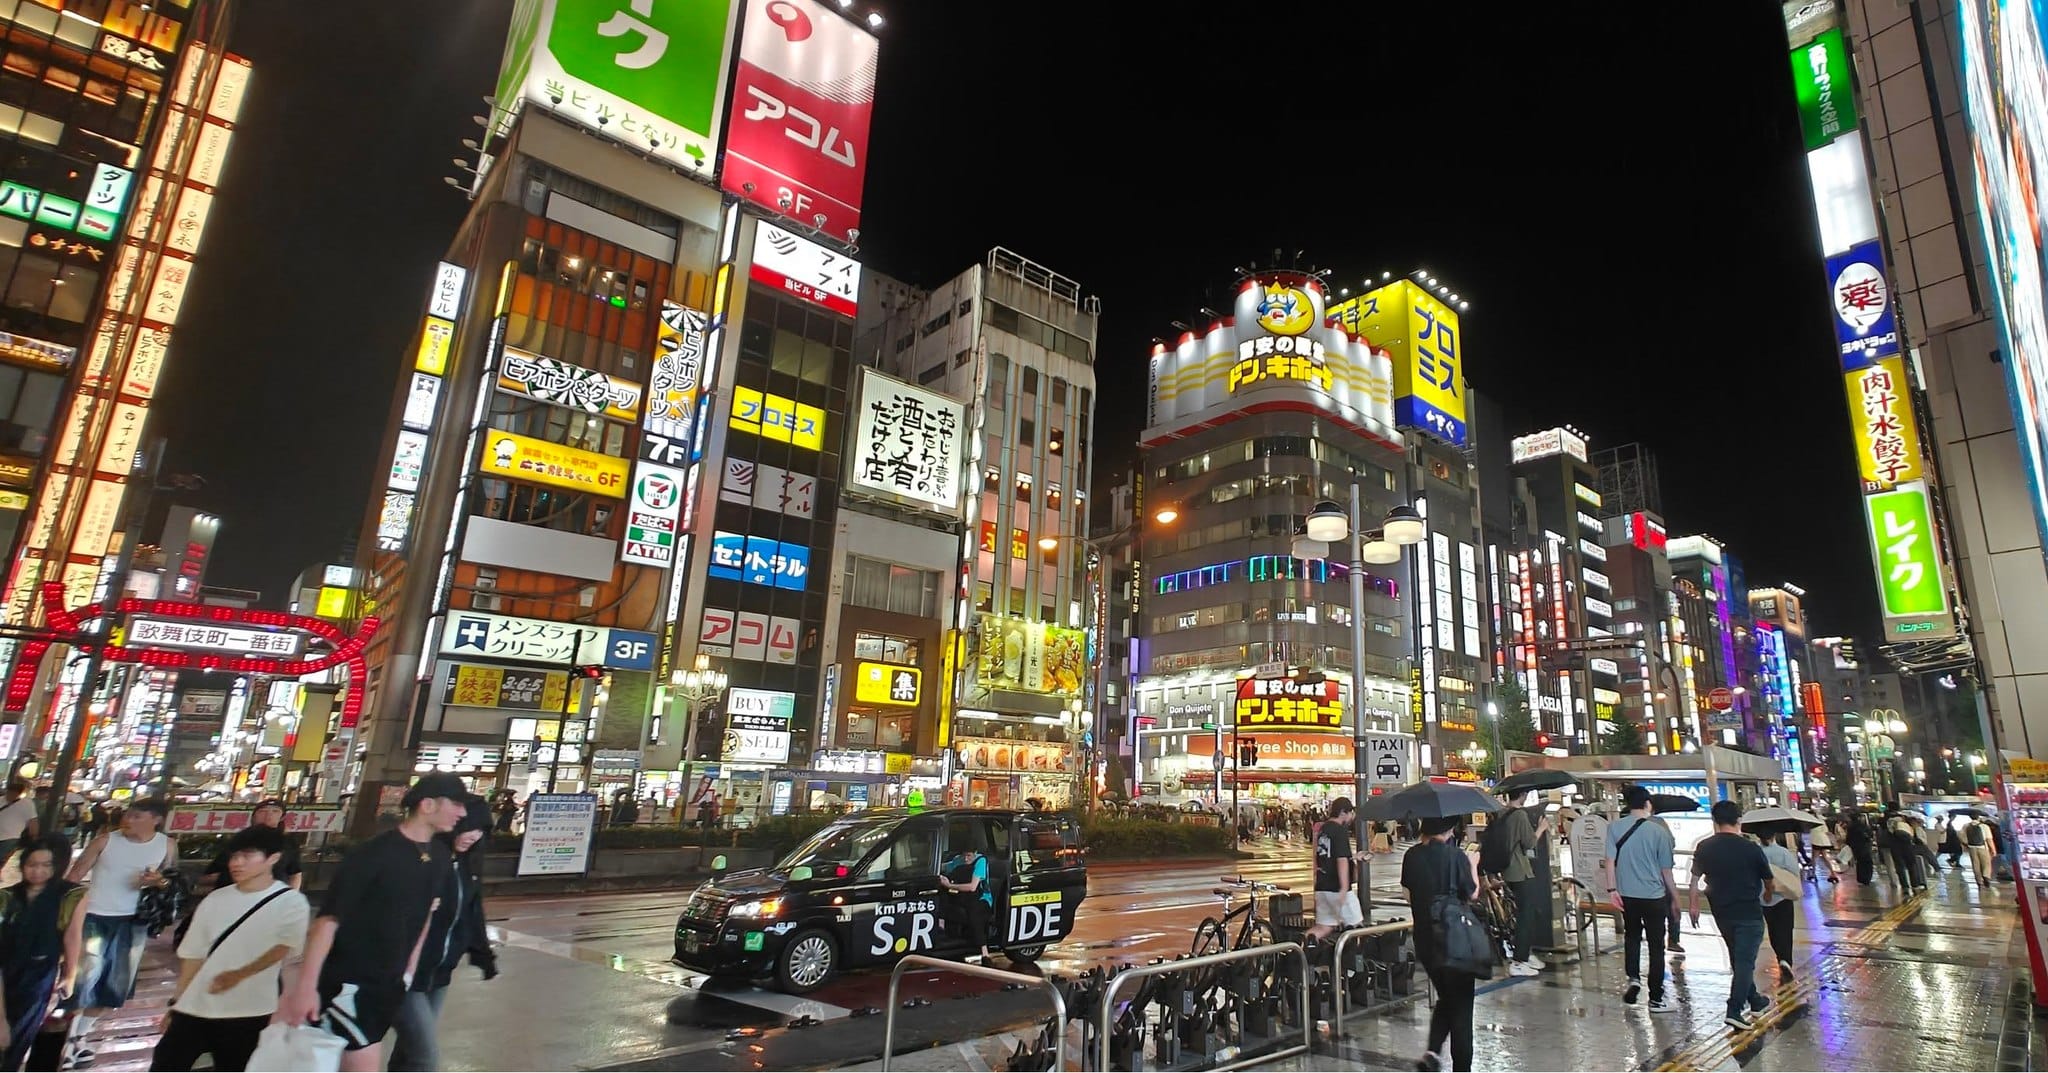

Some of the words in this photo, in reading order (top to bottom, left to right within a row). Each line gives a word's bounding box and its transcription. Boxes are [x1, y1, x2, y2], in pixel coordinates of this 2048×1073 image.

[597, 0, 669, 69] ク
[544, 77, 677, 149] 当ビルとなり
[744, 84, 857, 168] アコム
[97, 169, 122, 204] ダーツ
[777, 186, 813, 215] 3F
[436, 269, 457, 313] 小松ビル
[784, 278, 812, 297] 当ビル
[1838, 277, 1882, 311] 薬
[652, 356, 675, 417] &ダーツ
[740, 400, 816, 436] プロミス
[1861, 370, 1913, 484] 肉汁水餃子
[646, 434, 685, 465] 7F
[862, 400, 892, 483] だけの店
[888, 394, 925, 490] 酒と肴
[917, 412, 937, 493] こだわりの
[598, 471, 622, 488] 6F
[1866, 480, 1883, 493] B1
[633, 513, 671, 531] たばこ
[628, 543, 669, 561] ATM
[714, 543, 807, 578] セントラル
[1883, 511, 1925, 591] レイク
[753, 575, 766, 583] 4F
[136, 622, 293, 651] 歌舞伎町一番街
[494, 619, 600, 644] メンズライフ
[702, 614, 795, 650] アコム
[492, 638, 577, 662] クリニック
[614, 640, 649, 660] 3F
[892, 671, 917, 700] 集
[735, 697, 768, 711] BUY
[1170, 706, 1184, 714] Don
[1185, 703, 1212, 715] Quijote
[744, 735, 785, 749] SELL
[1256, 742, 1281, 754] ree
[1285, 741, 1319, 756] Shop
[1371, 739, 1404, 751] TAXI
[892, 890, 906, 898] km
[836, 914, 852, 923] TAXI
[1008, 903, 1062, 942] IDE
